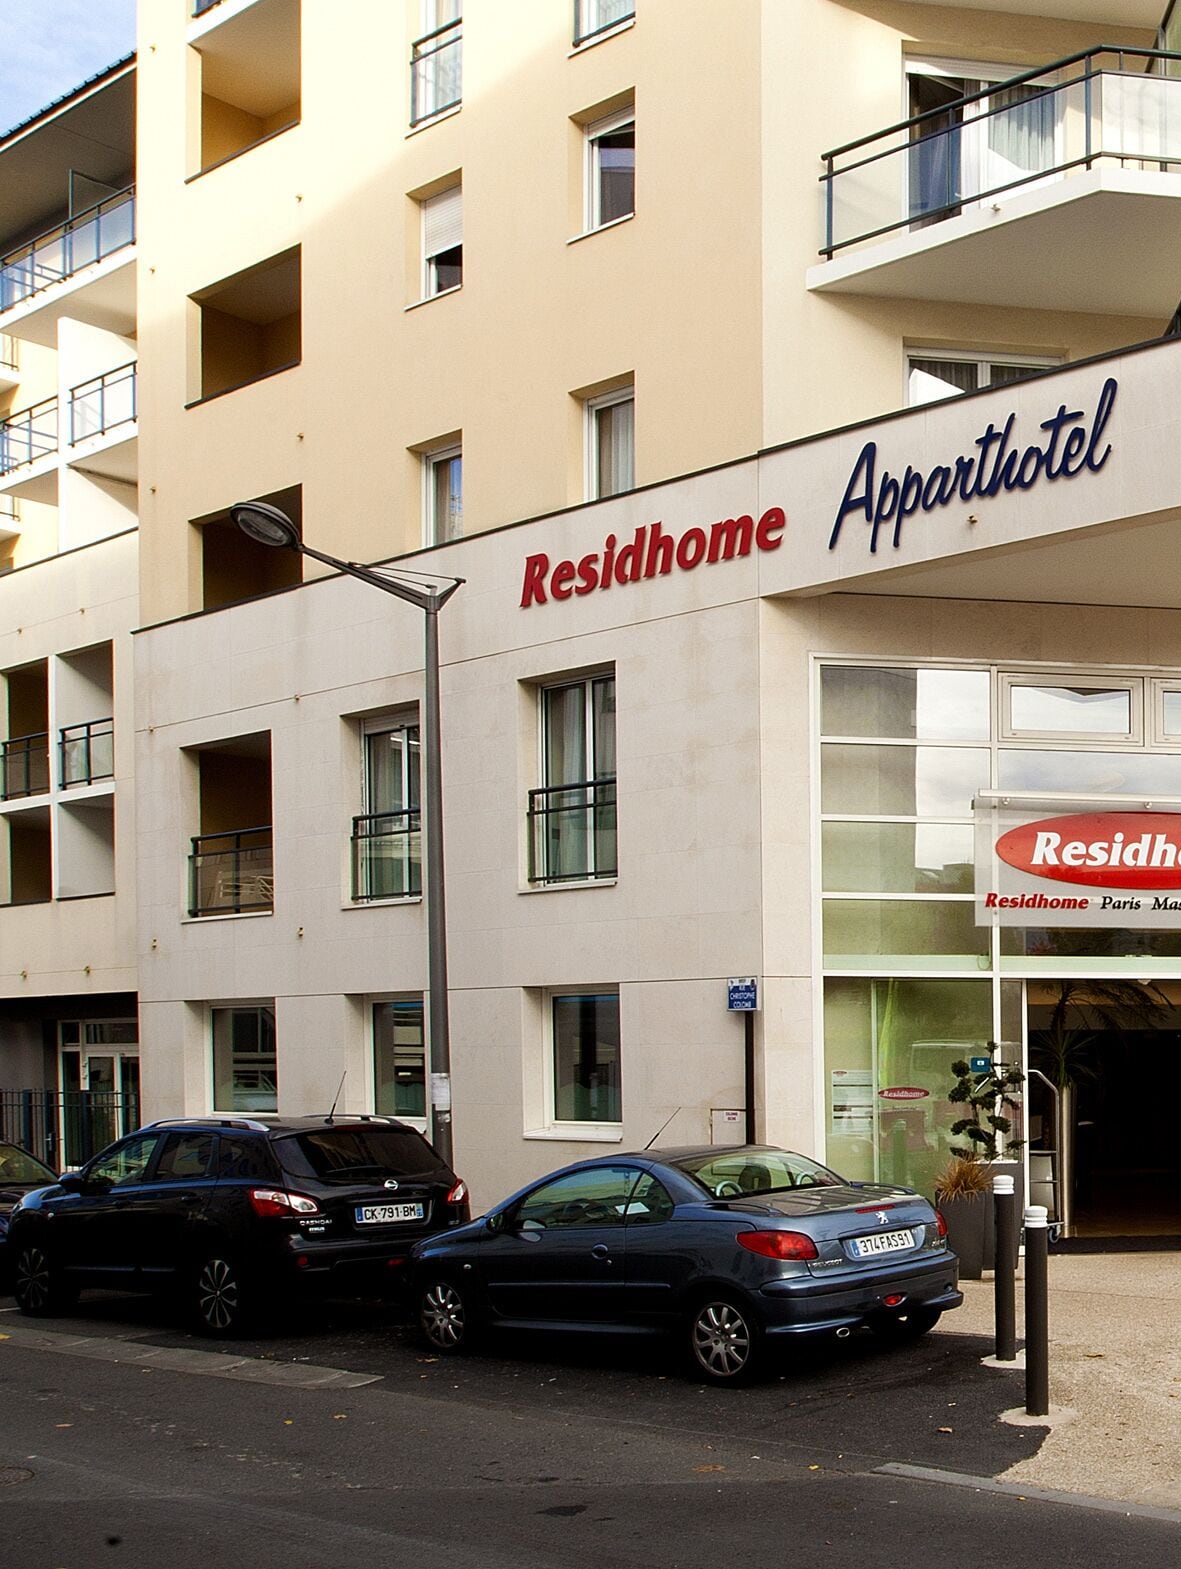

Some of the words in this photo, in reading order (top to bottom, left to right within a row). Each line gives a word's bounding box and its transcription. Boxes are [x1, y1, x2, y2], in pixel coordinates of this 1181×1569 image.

[519, 506, 786, 609] Residhome
[829, 377, 1119, 553] Apparthotel
[985, 892, 1090, 910] Residhome
[1100, 895, 1142, 911] Paris
[883, 1090, 925, 1098] Residhome
